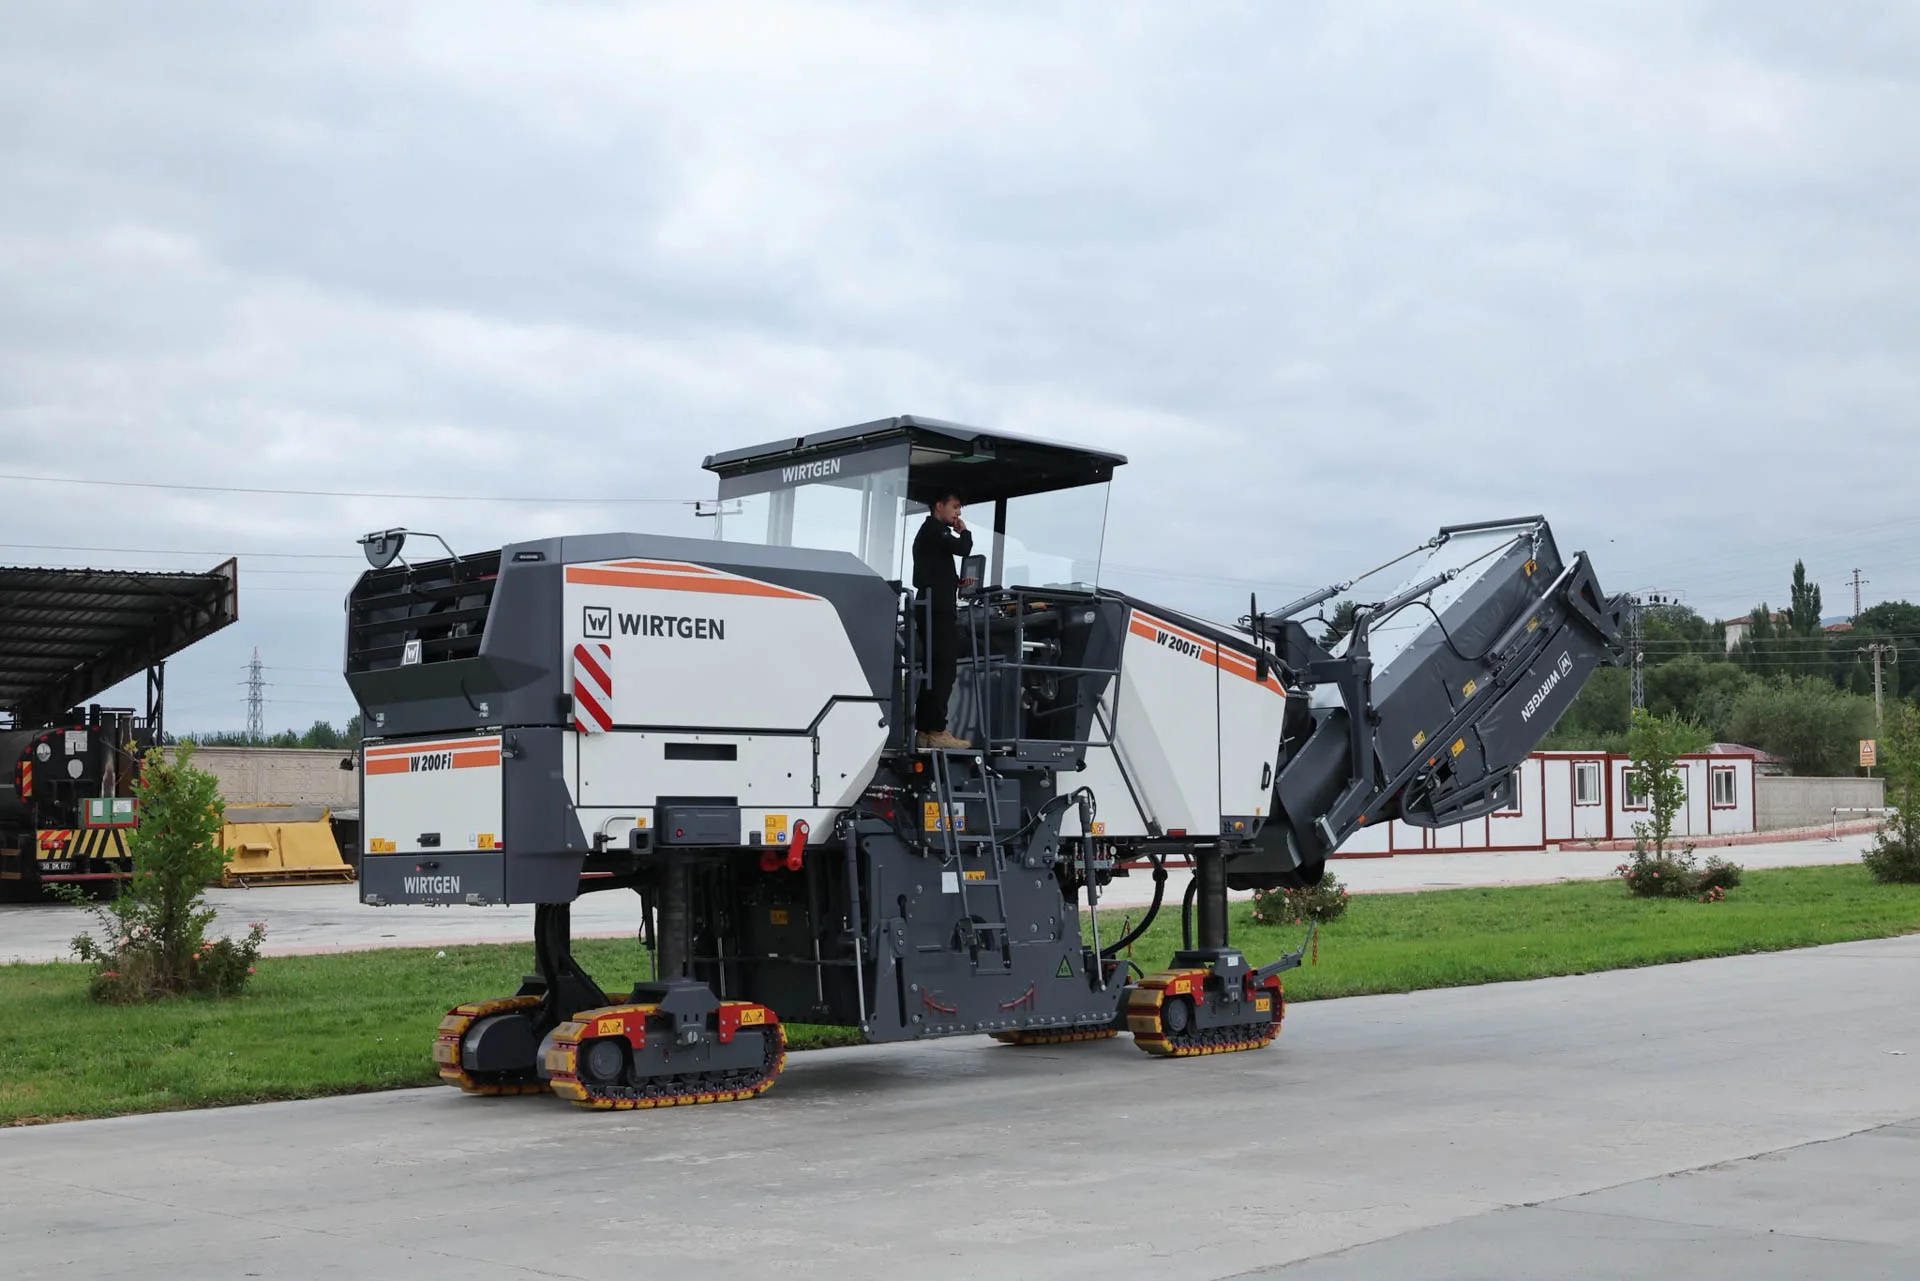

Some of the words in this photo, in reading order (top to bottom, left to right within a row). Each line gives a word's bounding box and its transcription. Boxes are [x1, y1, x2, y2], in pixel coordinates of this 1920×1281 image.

[782, 458, 841, 483] WIRTGEN
[618, 613, 725, 640] WIRTGEN
[1157, 630, 1169, 646] W
[1521, 669, 1561, 723] WIRTGEN
[410, 756, 420, 772] W
[404, 875, 460, 894] WIRTGEN
